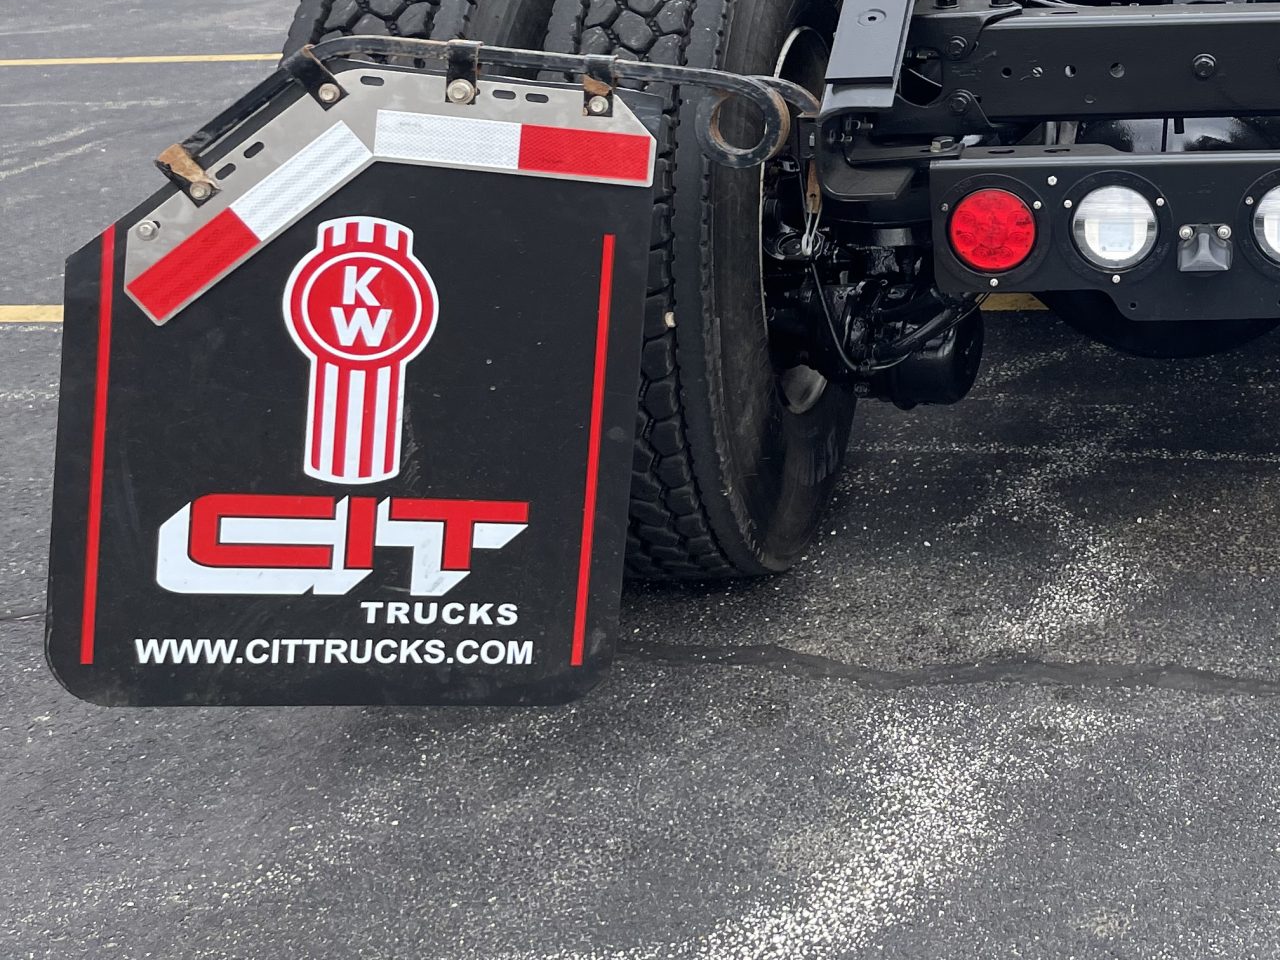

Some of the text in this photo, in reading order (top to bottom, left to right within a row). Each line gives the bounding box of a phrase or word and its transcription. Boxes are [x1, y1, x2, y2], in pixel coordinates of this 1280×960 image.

[342, 266, 382, 307] K
[329, 307, 392, 347] W
[156, 493, 530, 595] CIT
[360, 601, 519, 626] TRUCKS
[134, 638, 534, 665] WWW.CITTRUCKS.COM
